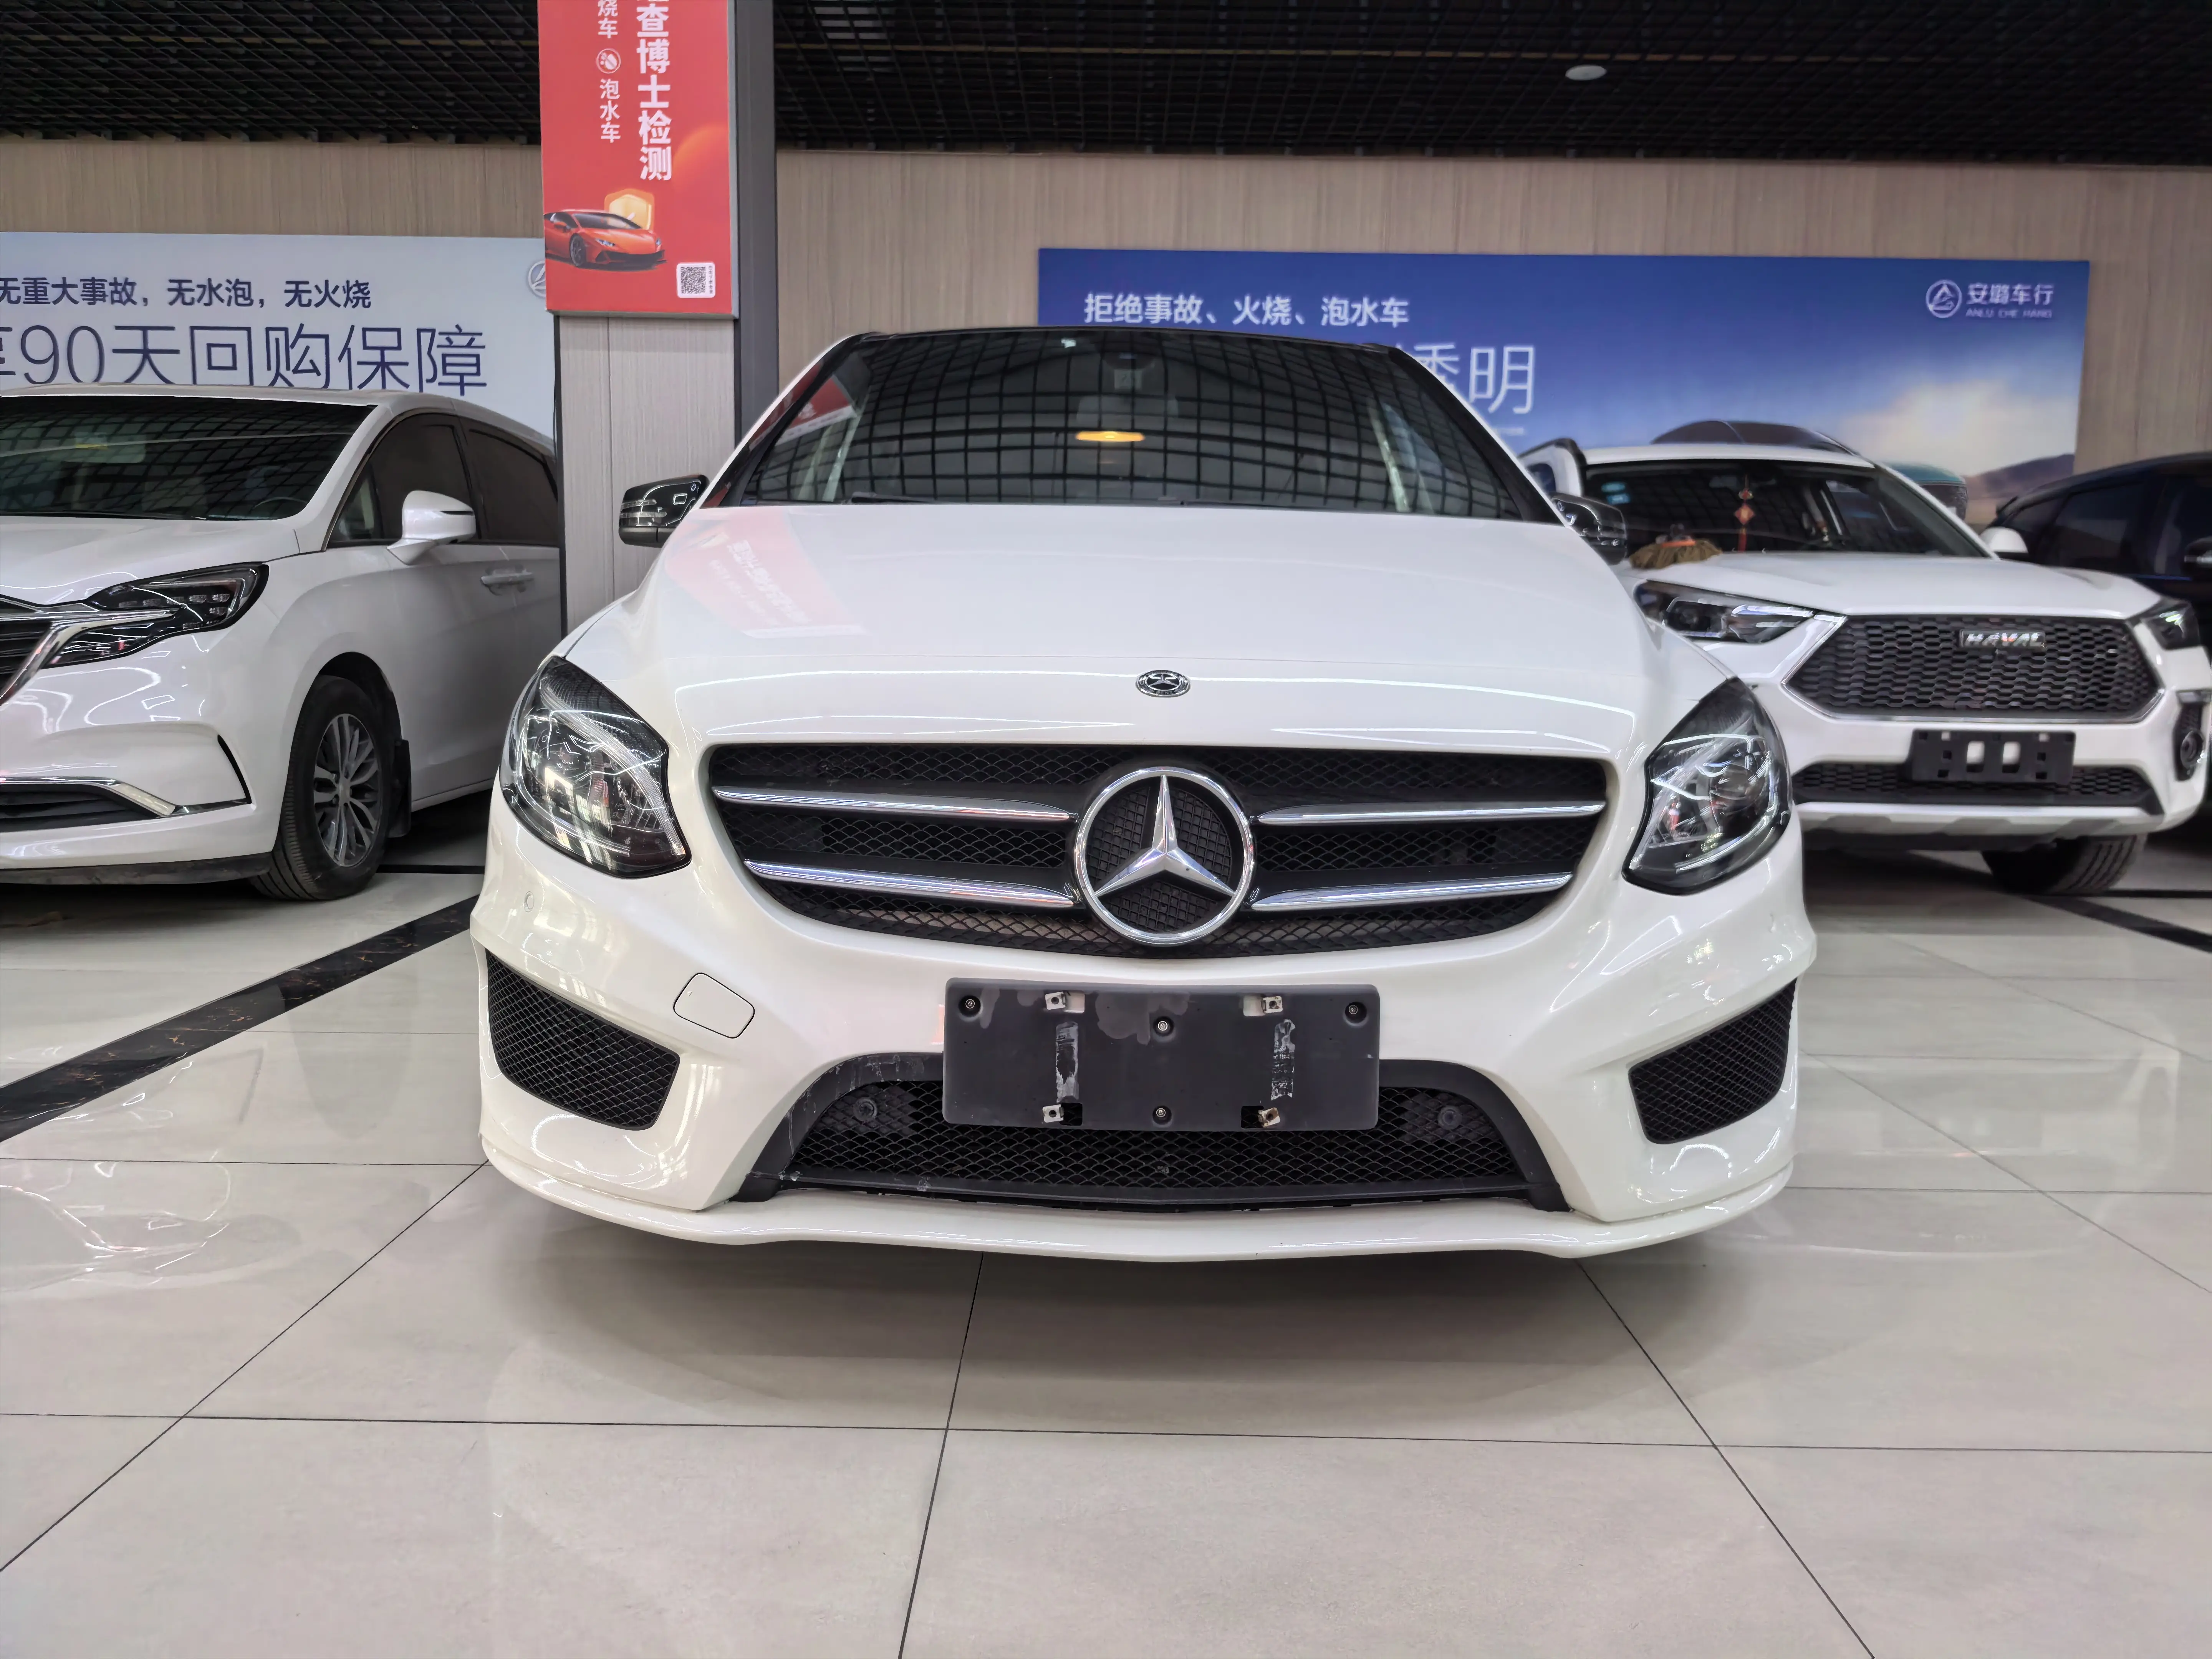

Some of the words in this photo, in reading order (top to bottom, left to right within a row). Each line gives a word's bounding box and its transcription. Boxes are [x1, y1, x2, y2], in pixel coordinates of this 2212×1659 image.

[599, 79, 621, 143] 泡水车
[636, 3, 672, 180] 查博士检测
[1084, 293, 1409, 327] 拒绝事故、火烧、泡水车
[1965, 633, 2043, 647] HAVAL
